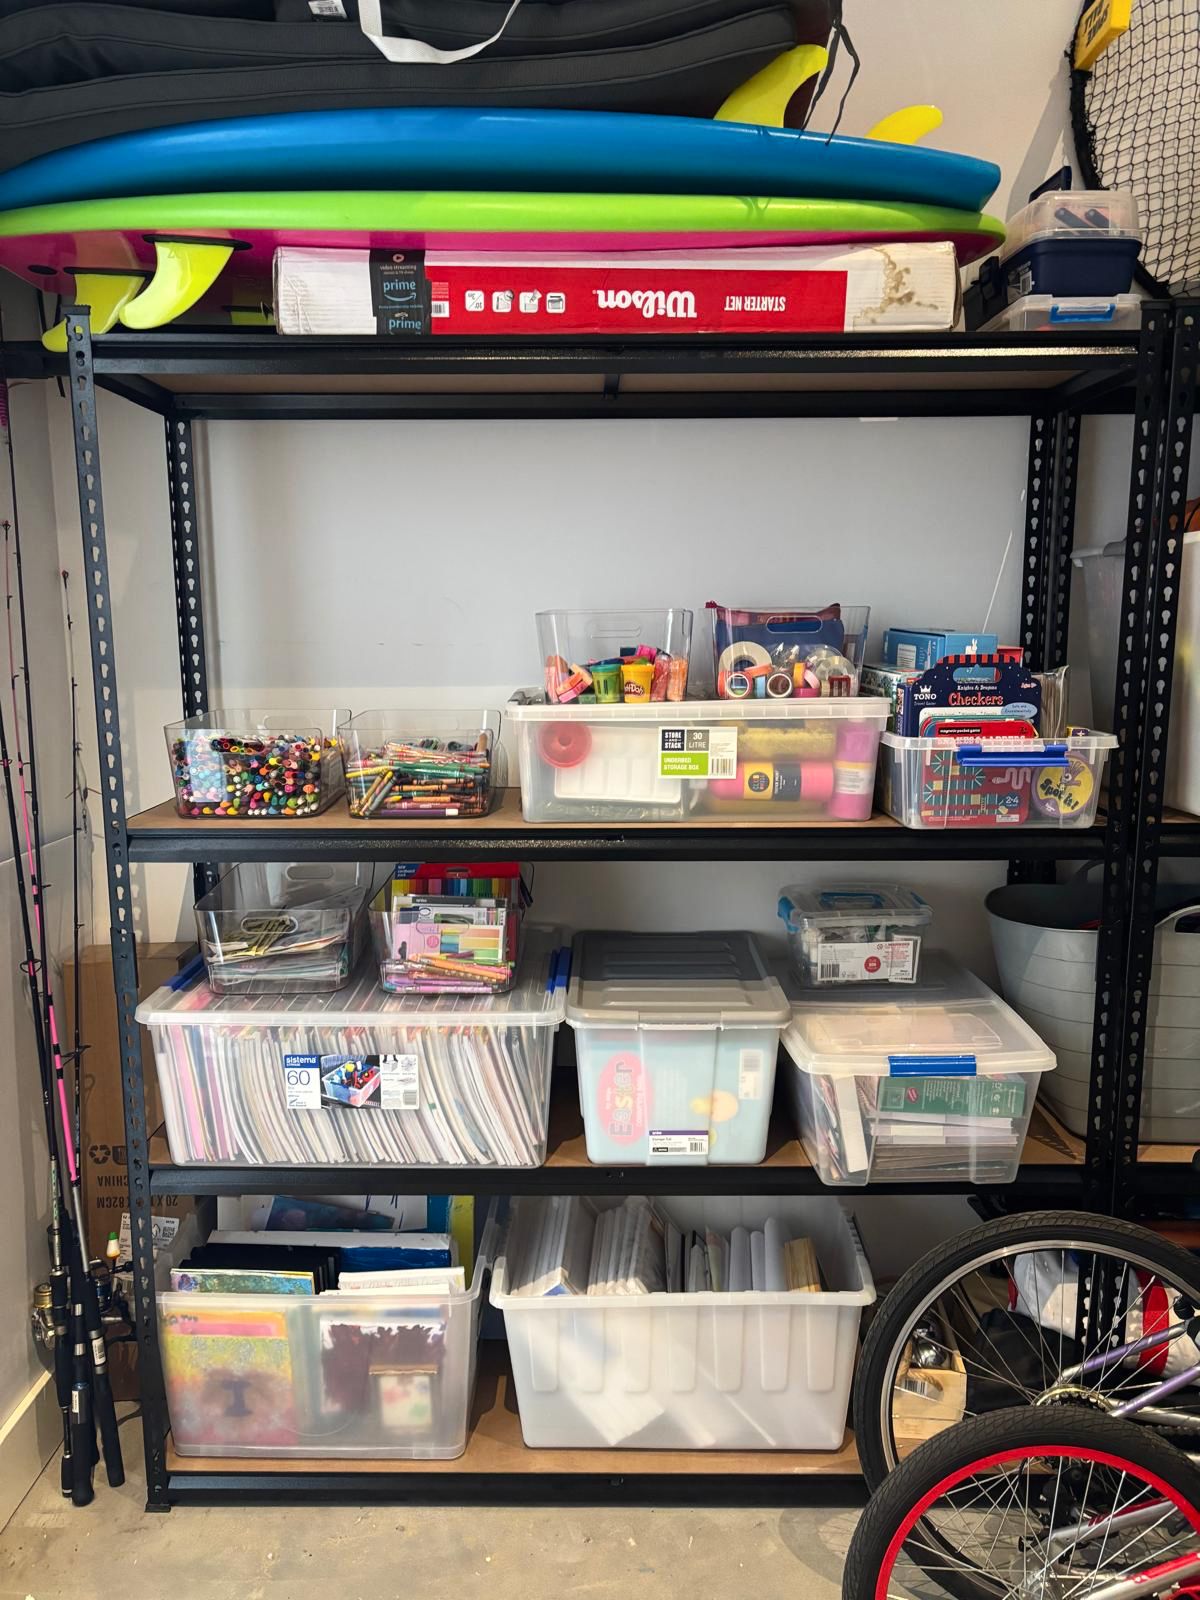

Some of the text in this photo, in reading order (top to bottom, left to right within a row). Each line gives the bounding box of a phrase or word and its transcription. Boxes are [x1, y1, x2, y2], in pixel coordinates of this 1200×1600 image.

[383, 279, 416, 293] prime
[597, 289, 697, 319] Wilson
[724, 296, 786, 312] STARTER NET
[389, 317, 421, 330] prime
[914, 693, 937, 701] TONO
[948, 692, 1004, 706] Checkers
[664, 731, 682, 739] STORE
[693, 732, 703, 740] 30
[286, 1056, 316, 1064] sistema
[287, 1070, 311, 1086] 60
[610, 1061, 633, 1136] Easter
[96, 1196, 125, 1209] 82CM
[166, 1194, 178, 1207] 20
